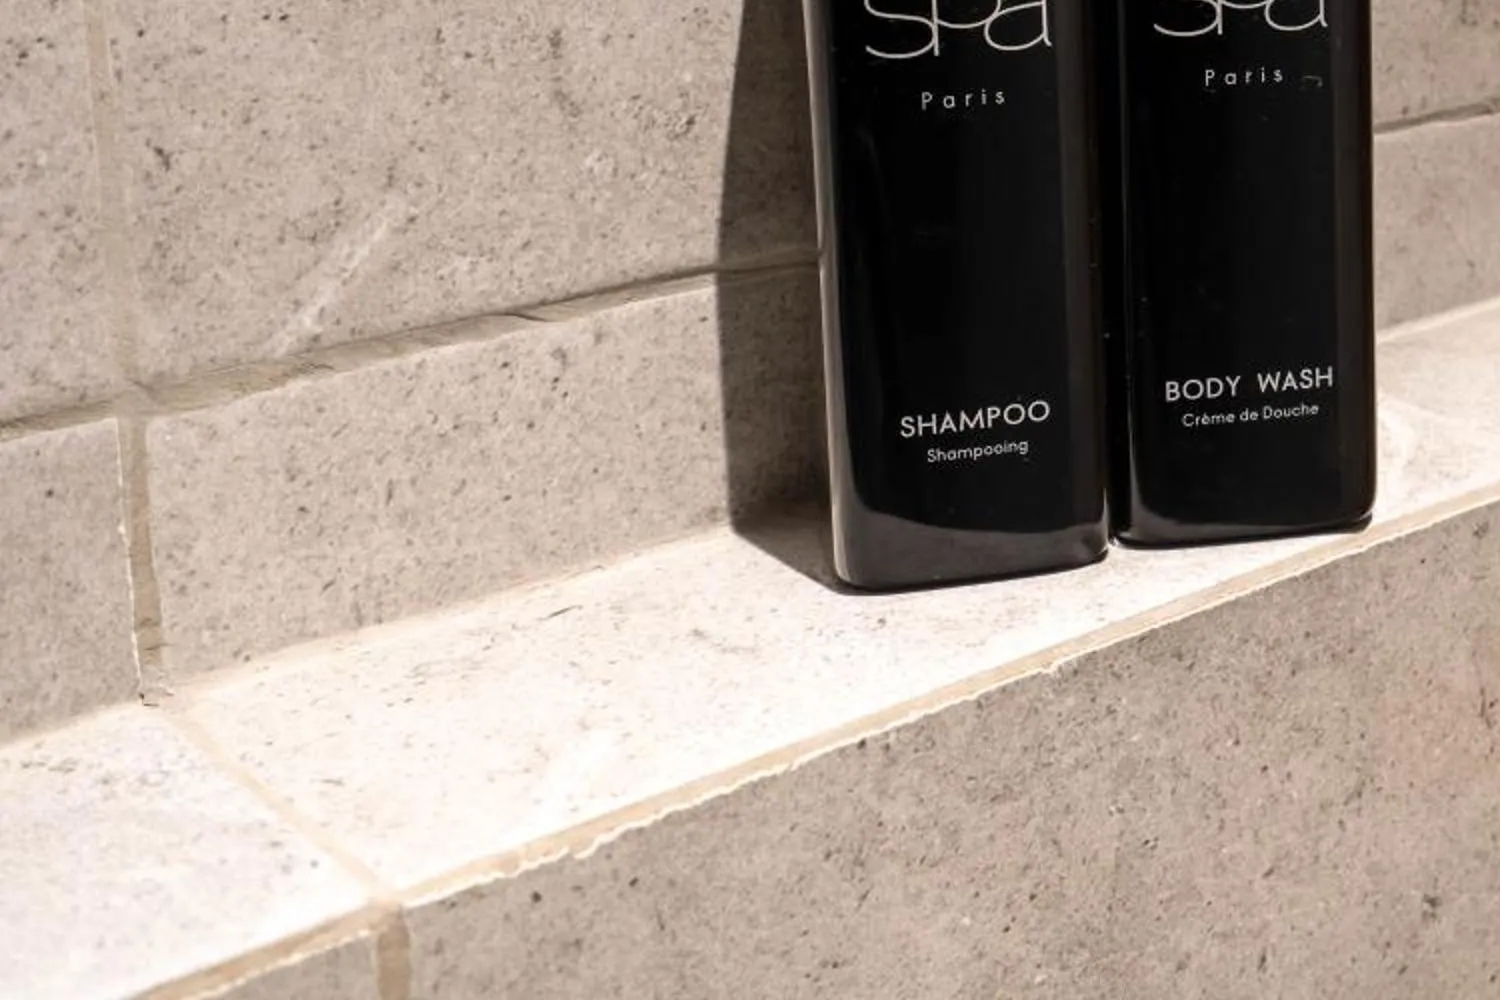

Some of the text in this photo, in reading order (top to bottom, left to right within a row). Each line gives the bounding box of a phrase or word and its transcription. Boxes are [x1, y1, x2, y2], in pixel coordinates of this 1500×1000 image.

[1204, 68, 1284, 87] Paris
[920, 90, 1006, 110] Paris
[1164, 365, 1334, 403] BODY WASH
[899, 399, 1051, 439] SHAMPOO
[1181, 402, 1320, 428] Crème de Douche
[926, 439, 1030, 464] Shampooing
